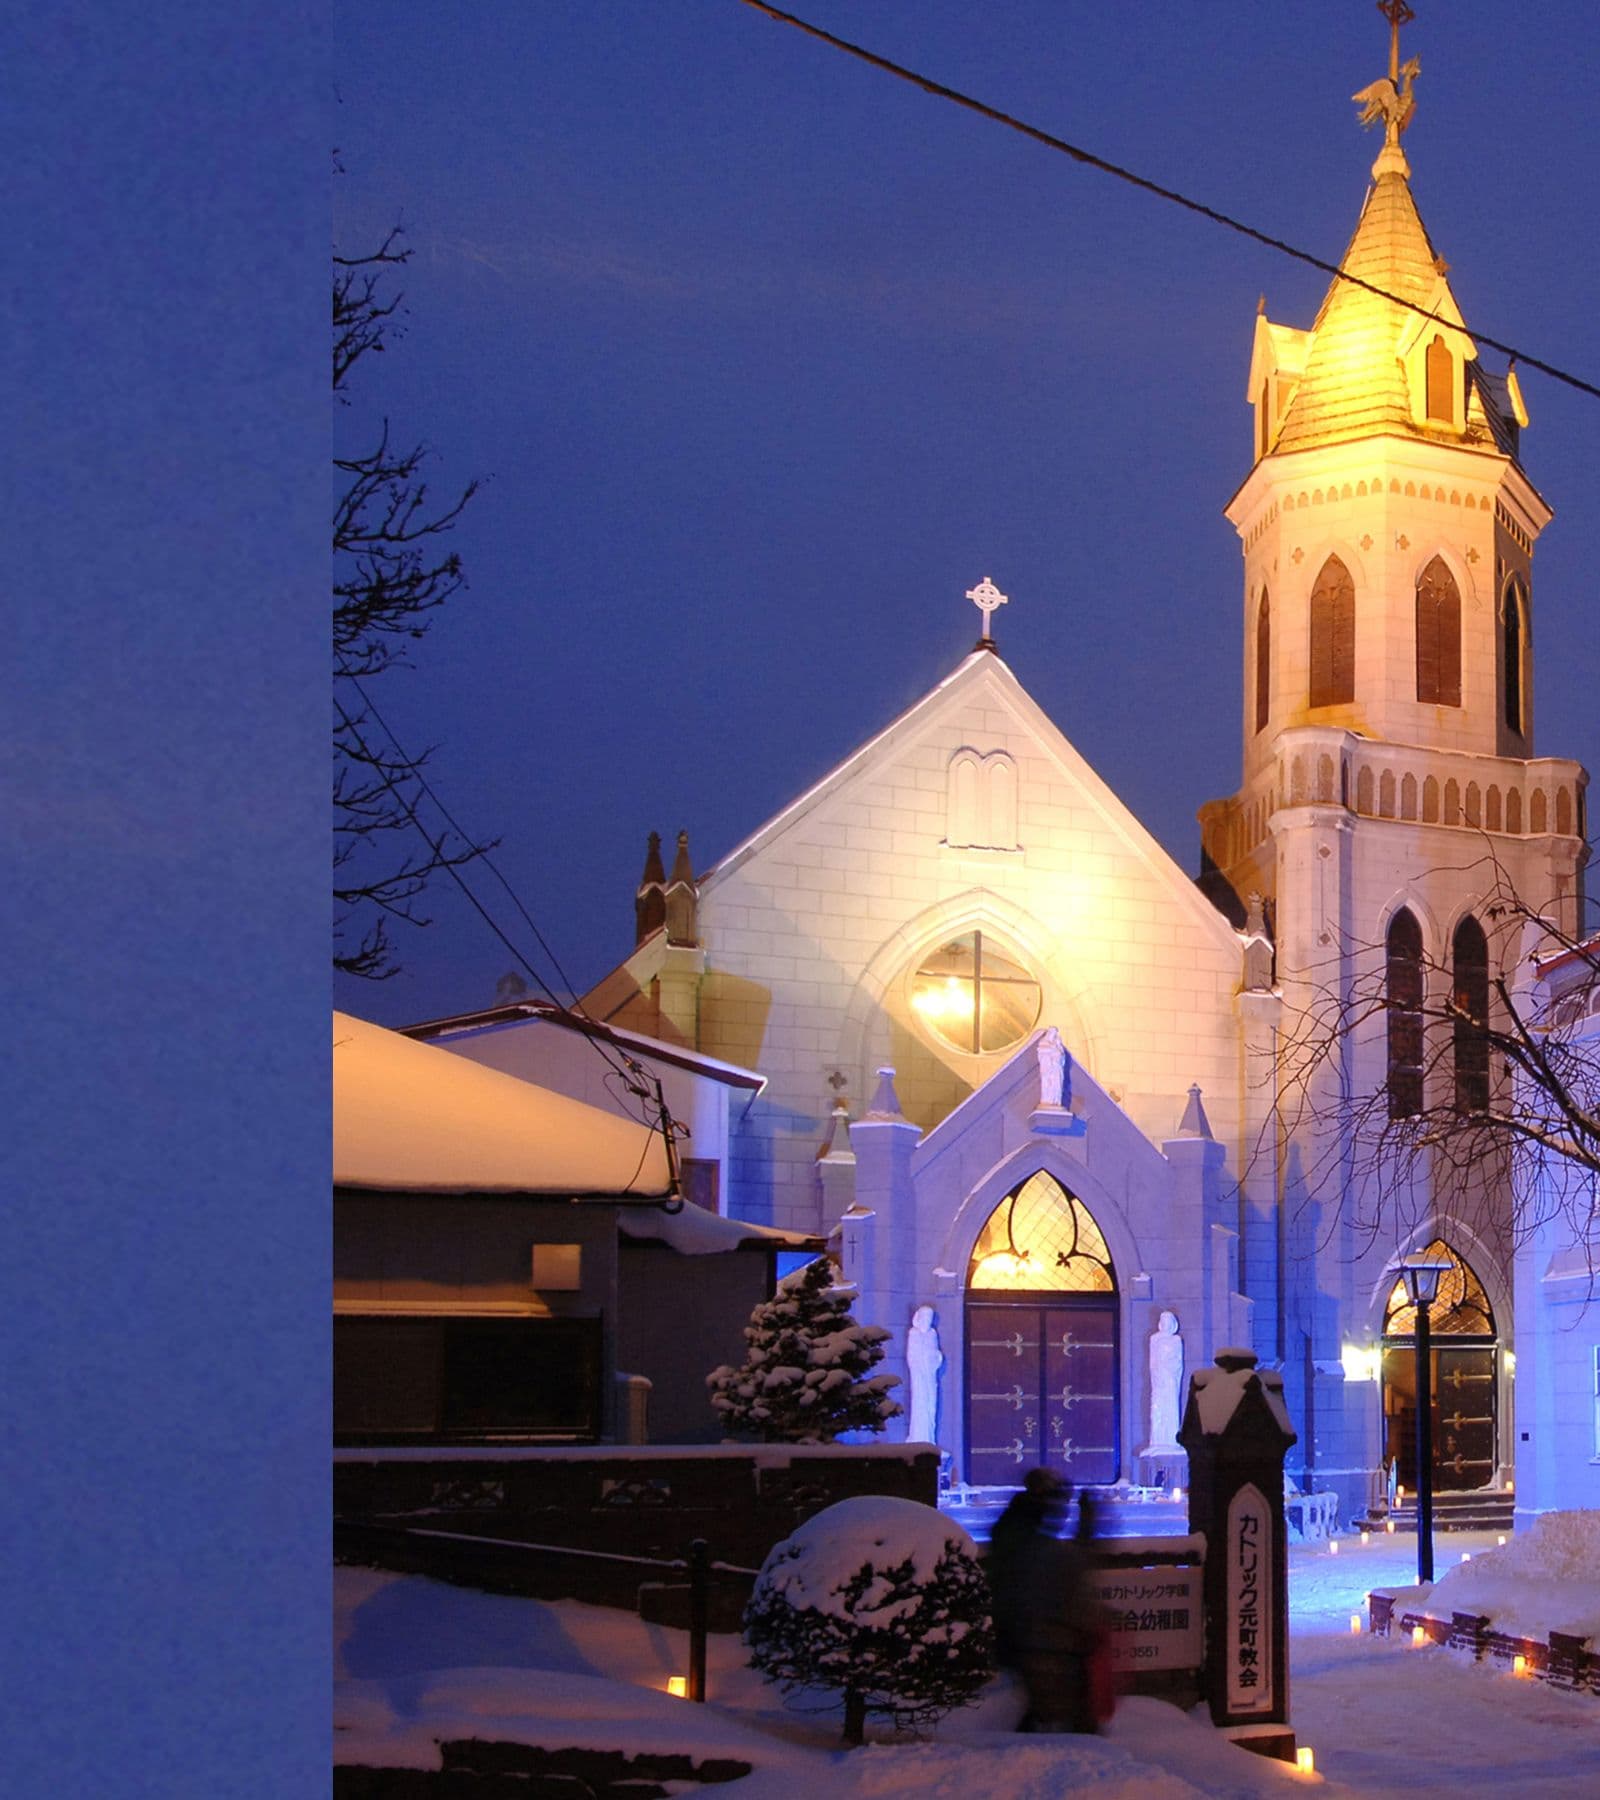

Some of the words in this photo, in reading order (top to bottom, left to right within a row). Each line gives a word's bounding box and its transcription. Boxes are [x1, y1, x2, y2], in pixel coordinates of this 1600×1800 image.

[1239, 1514, 1259, 1689] カトリック元町教会
